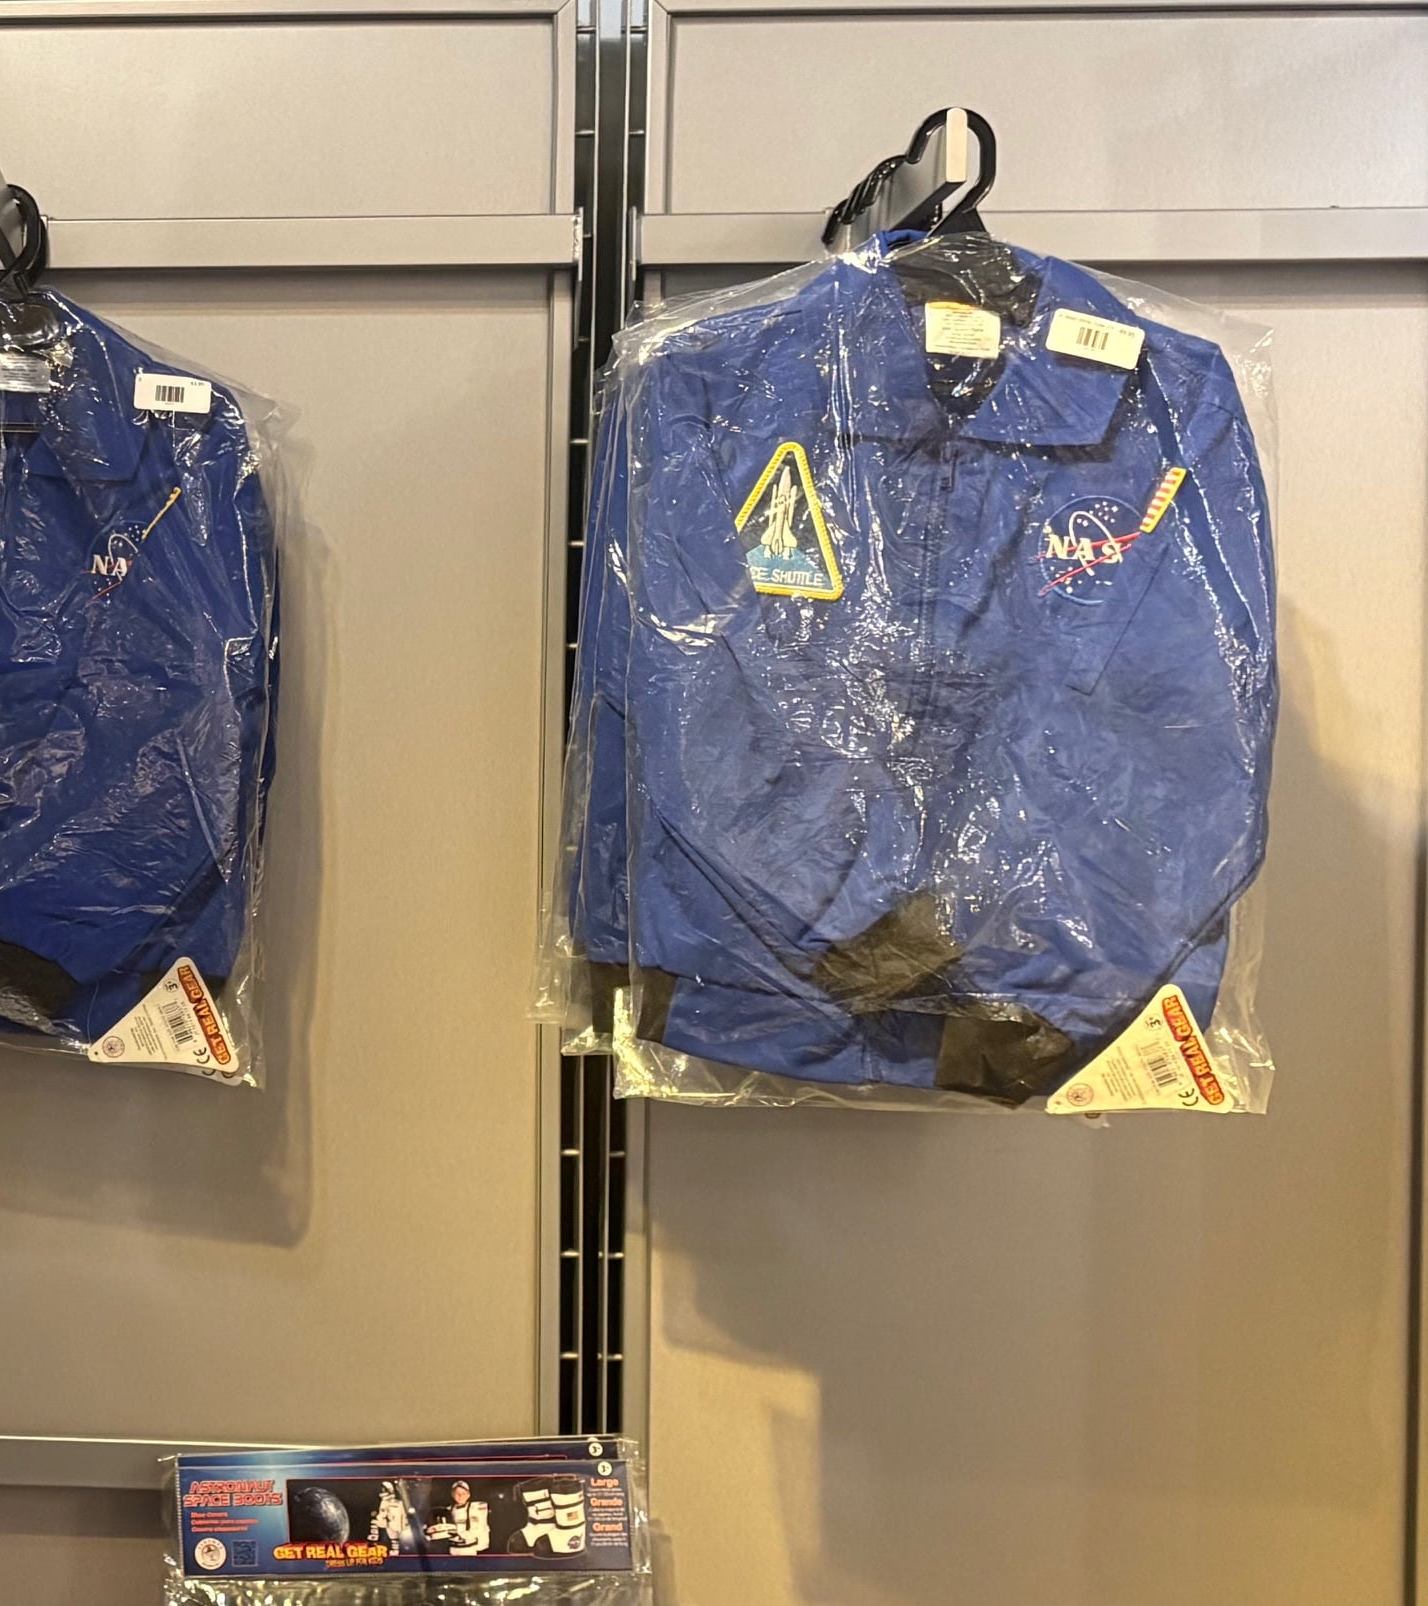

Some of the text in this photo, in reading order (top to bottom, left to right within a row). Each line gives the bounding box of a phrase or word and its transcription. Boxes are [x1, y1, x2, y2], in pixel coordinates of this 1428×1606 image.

[1045, 534, 1122, 564] NAS
[91, 554, 128, 577] NA
[771, 569, 825, 586] SHUTTLE
[177, 965, 204, 1004] GEAR
[193, 998, 221, 1035] REAL
[1162, 995, 1193, 1042] GEAR
[208, 1034, 231, 1065] GET
[1180, 1035, 1212, 1076] REAL
[1198, 1073, 1224, 1105] GET
[190, 1480, 275, 1494] ASTRONAUT
[591, 1478, 619, 1488] Large
[183, 1493, 283, 1507] SPACE BOOTS
[590, 1497, 623, 1507] Grande
[593, 1522, 623, 1532] Grand
[274, 1544, 388, 1559] GET REAL GEAR
